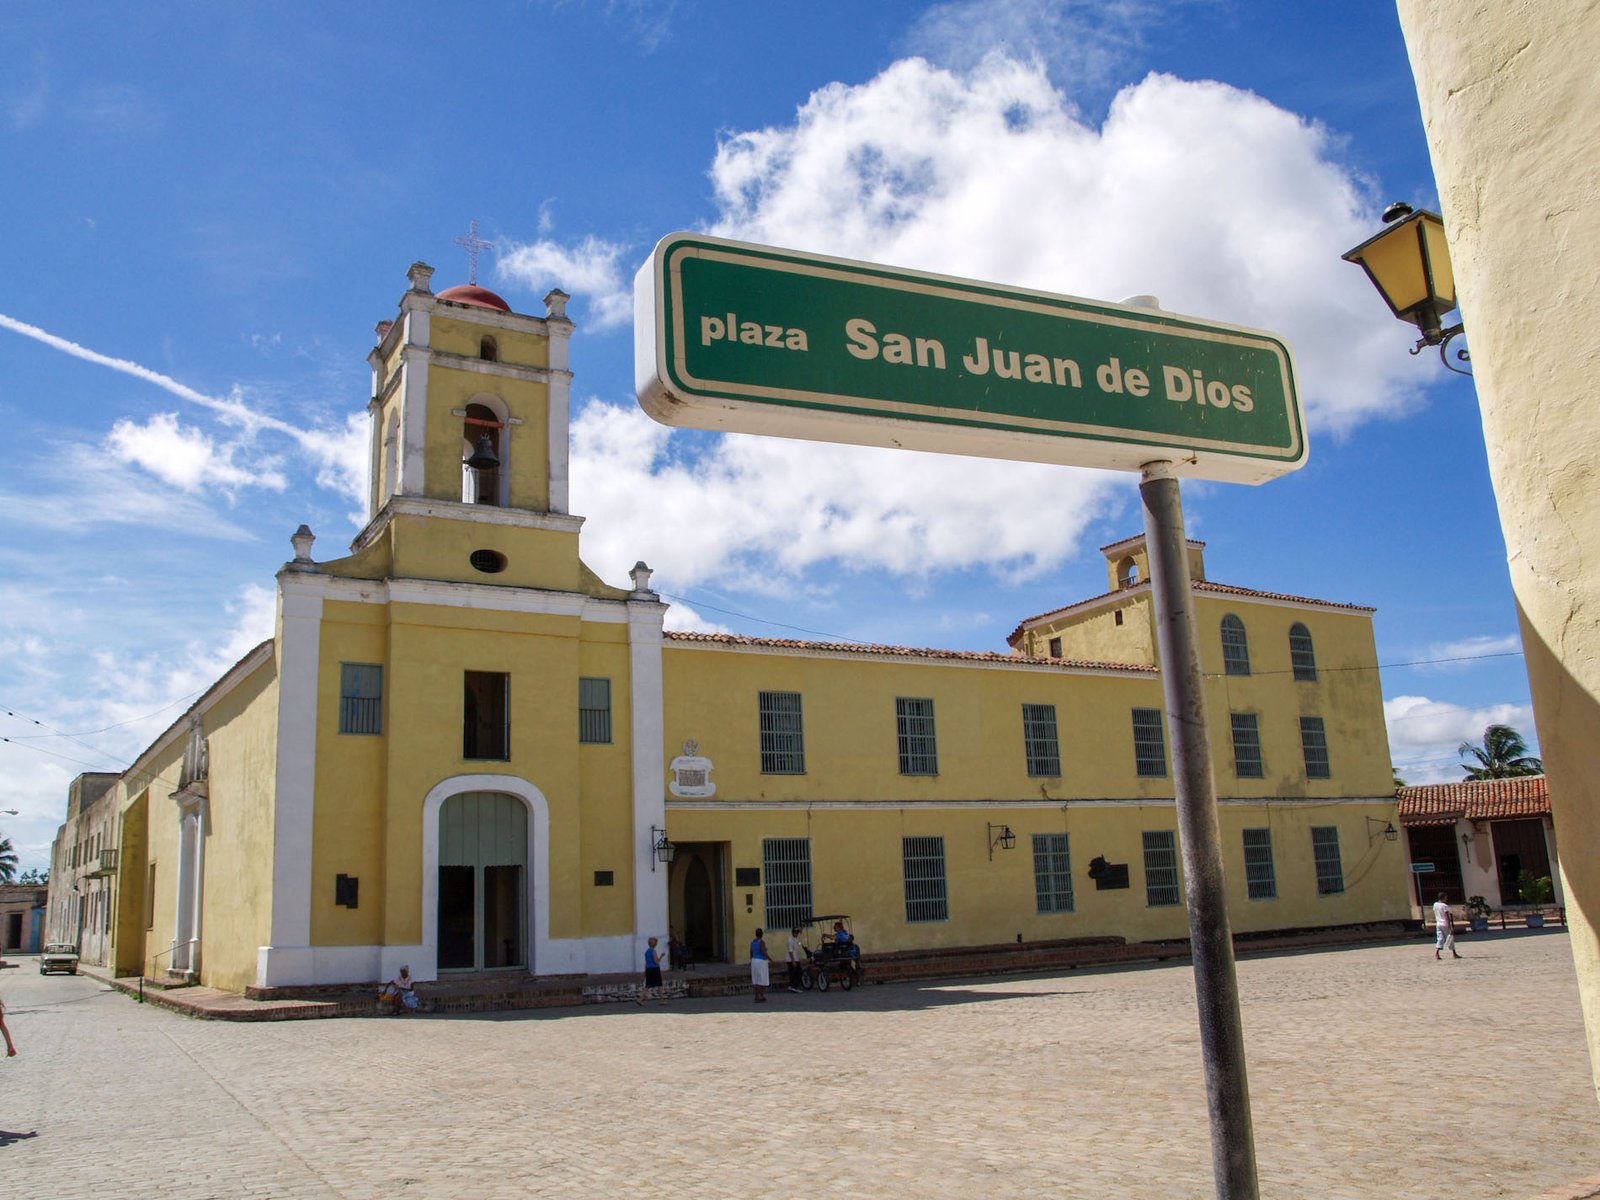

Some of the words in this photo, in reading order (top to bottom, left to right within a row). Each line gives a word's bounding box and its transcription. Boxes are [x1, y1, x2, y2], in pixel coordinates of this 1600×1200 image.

[701, 314, 808, 351] plaza
[846, 319, 946, 369] San
[963, 338, 1082, 388] Juan
[1097, 358, 1150, 397] de
[1163, 366, 1253, 412] Dios
